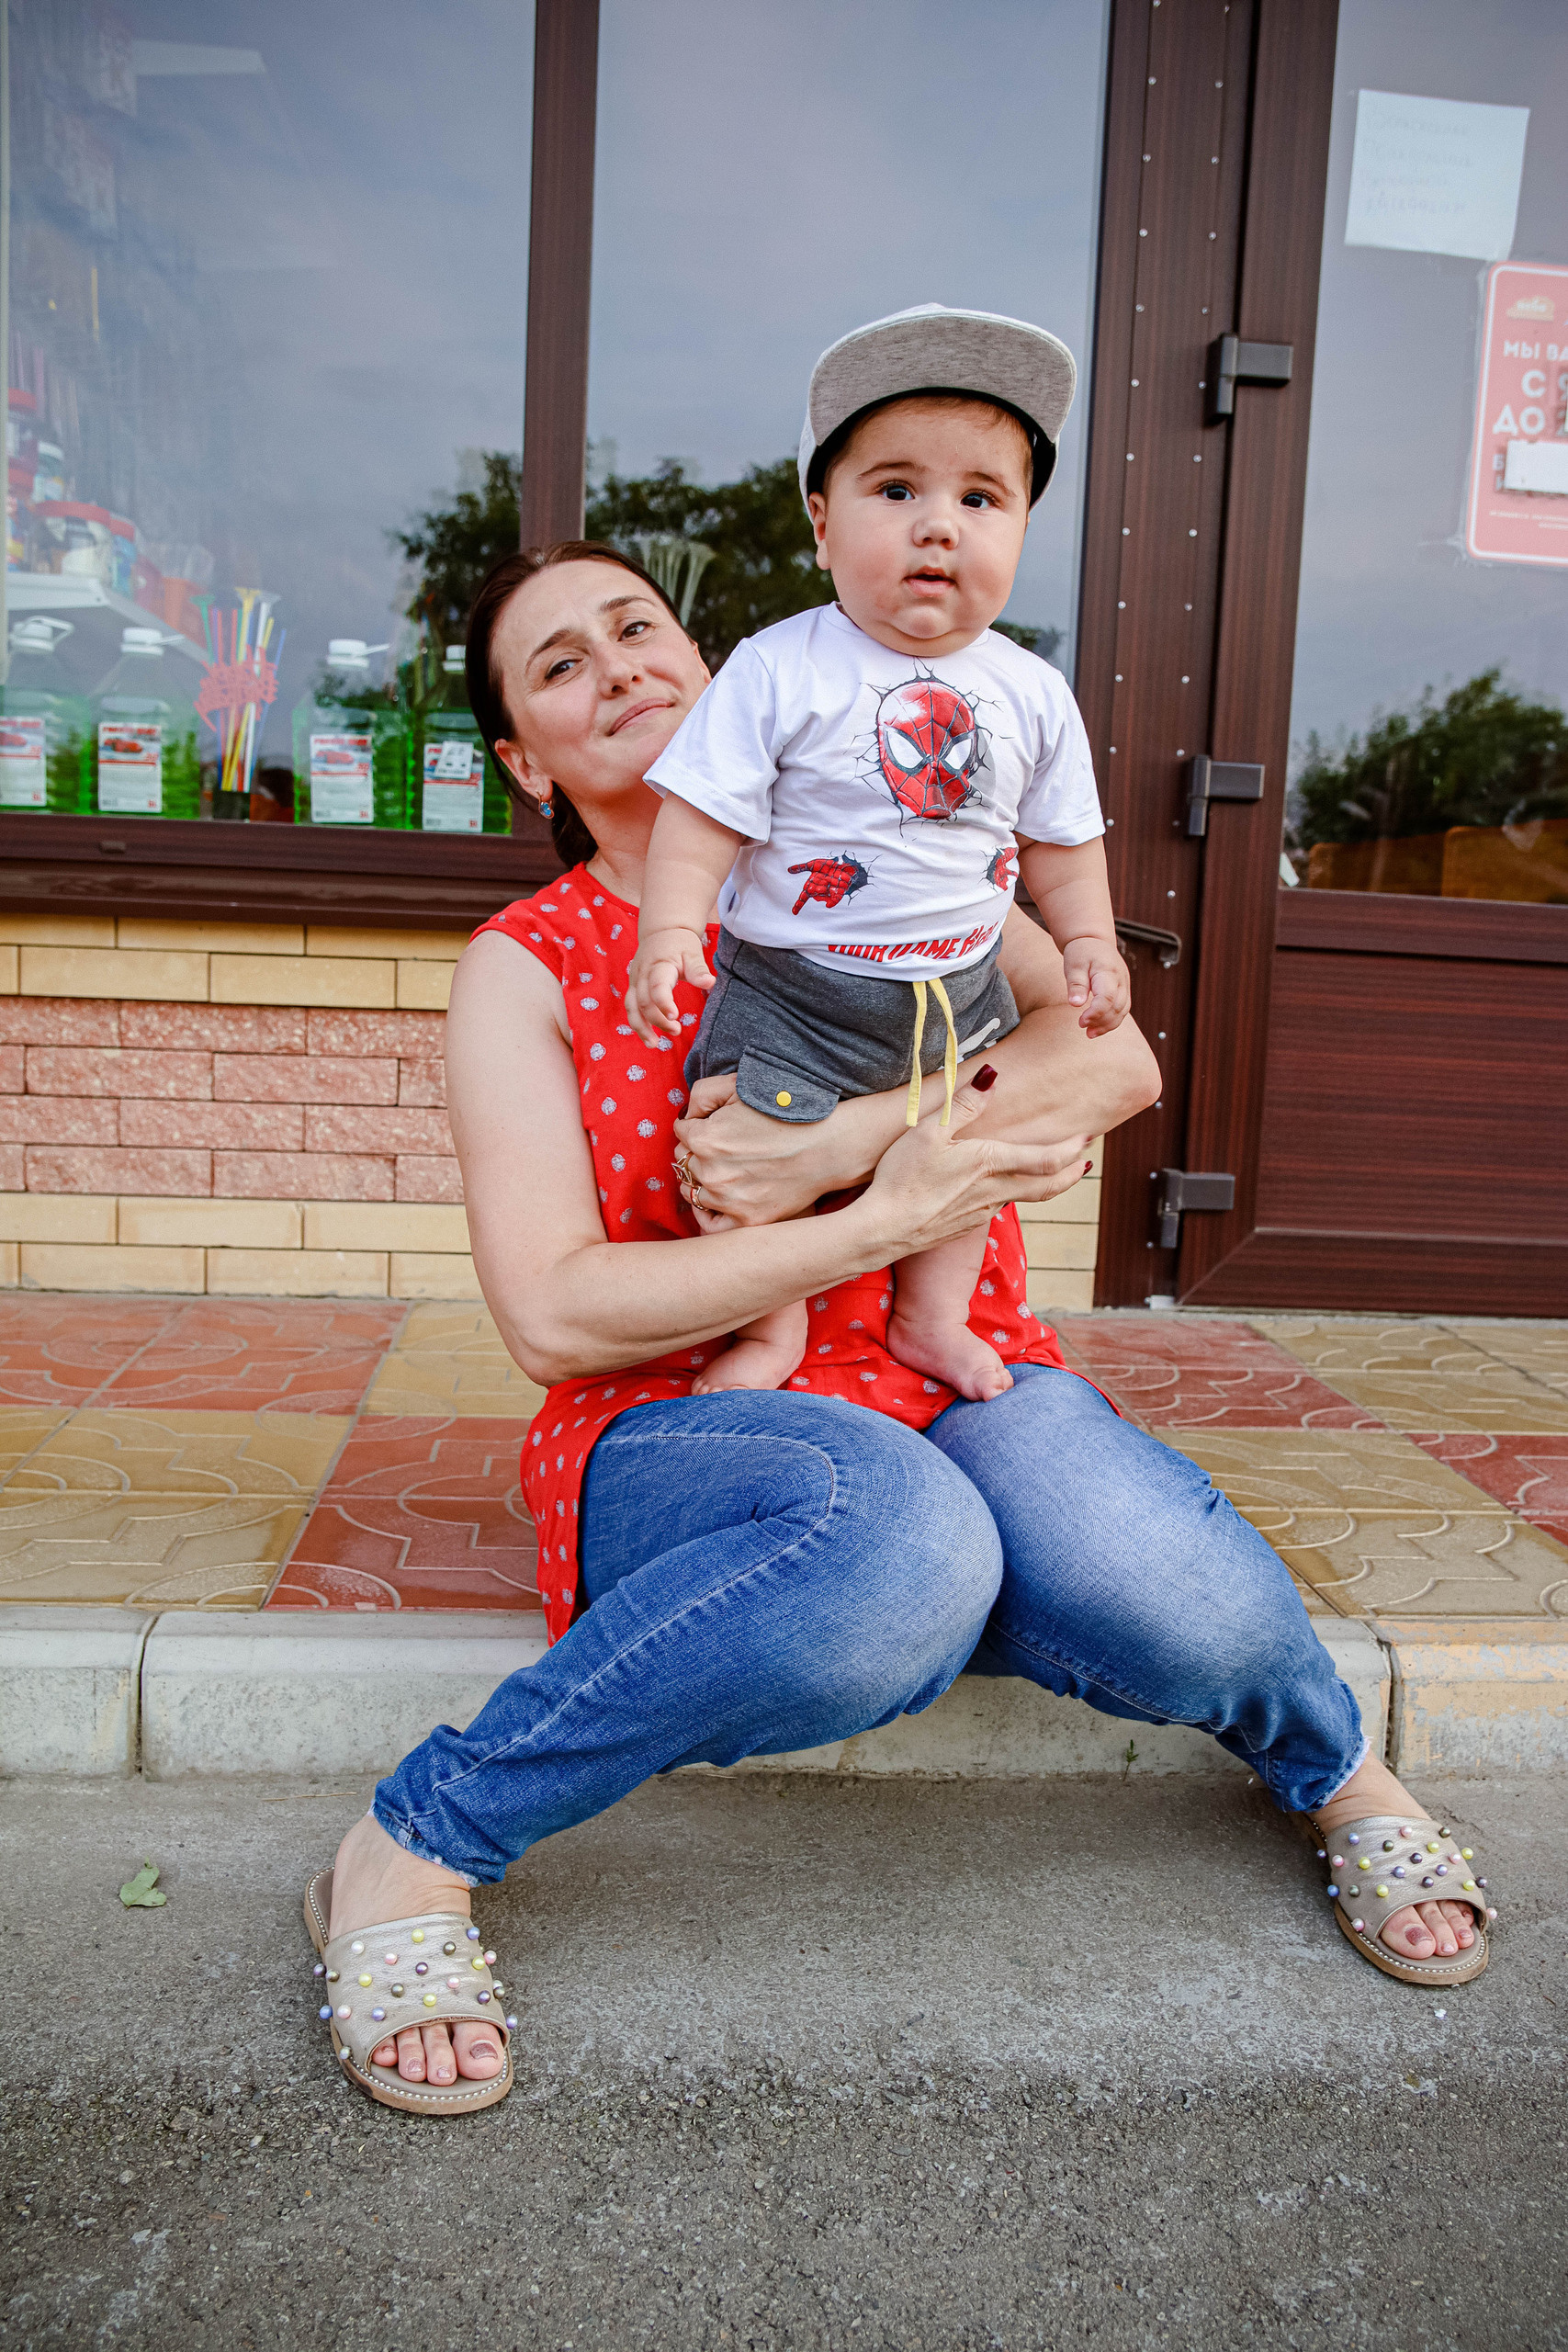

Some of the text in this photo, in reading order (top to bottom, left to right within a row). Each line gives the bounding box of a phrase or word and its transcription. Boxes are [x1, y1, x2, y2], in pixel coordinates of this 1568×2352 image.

[1503, 340, 1540, 359] МЫ
[1521, 369, 1546, 398] С
[1492, 405, 1545, 436] ДО
